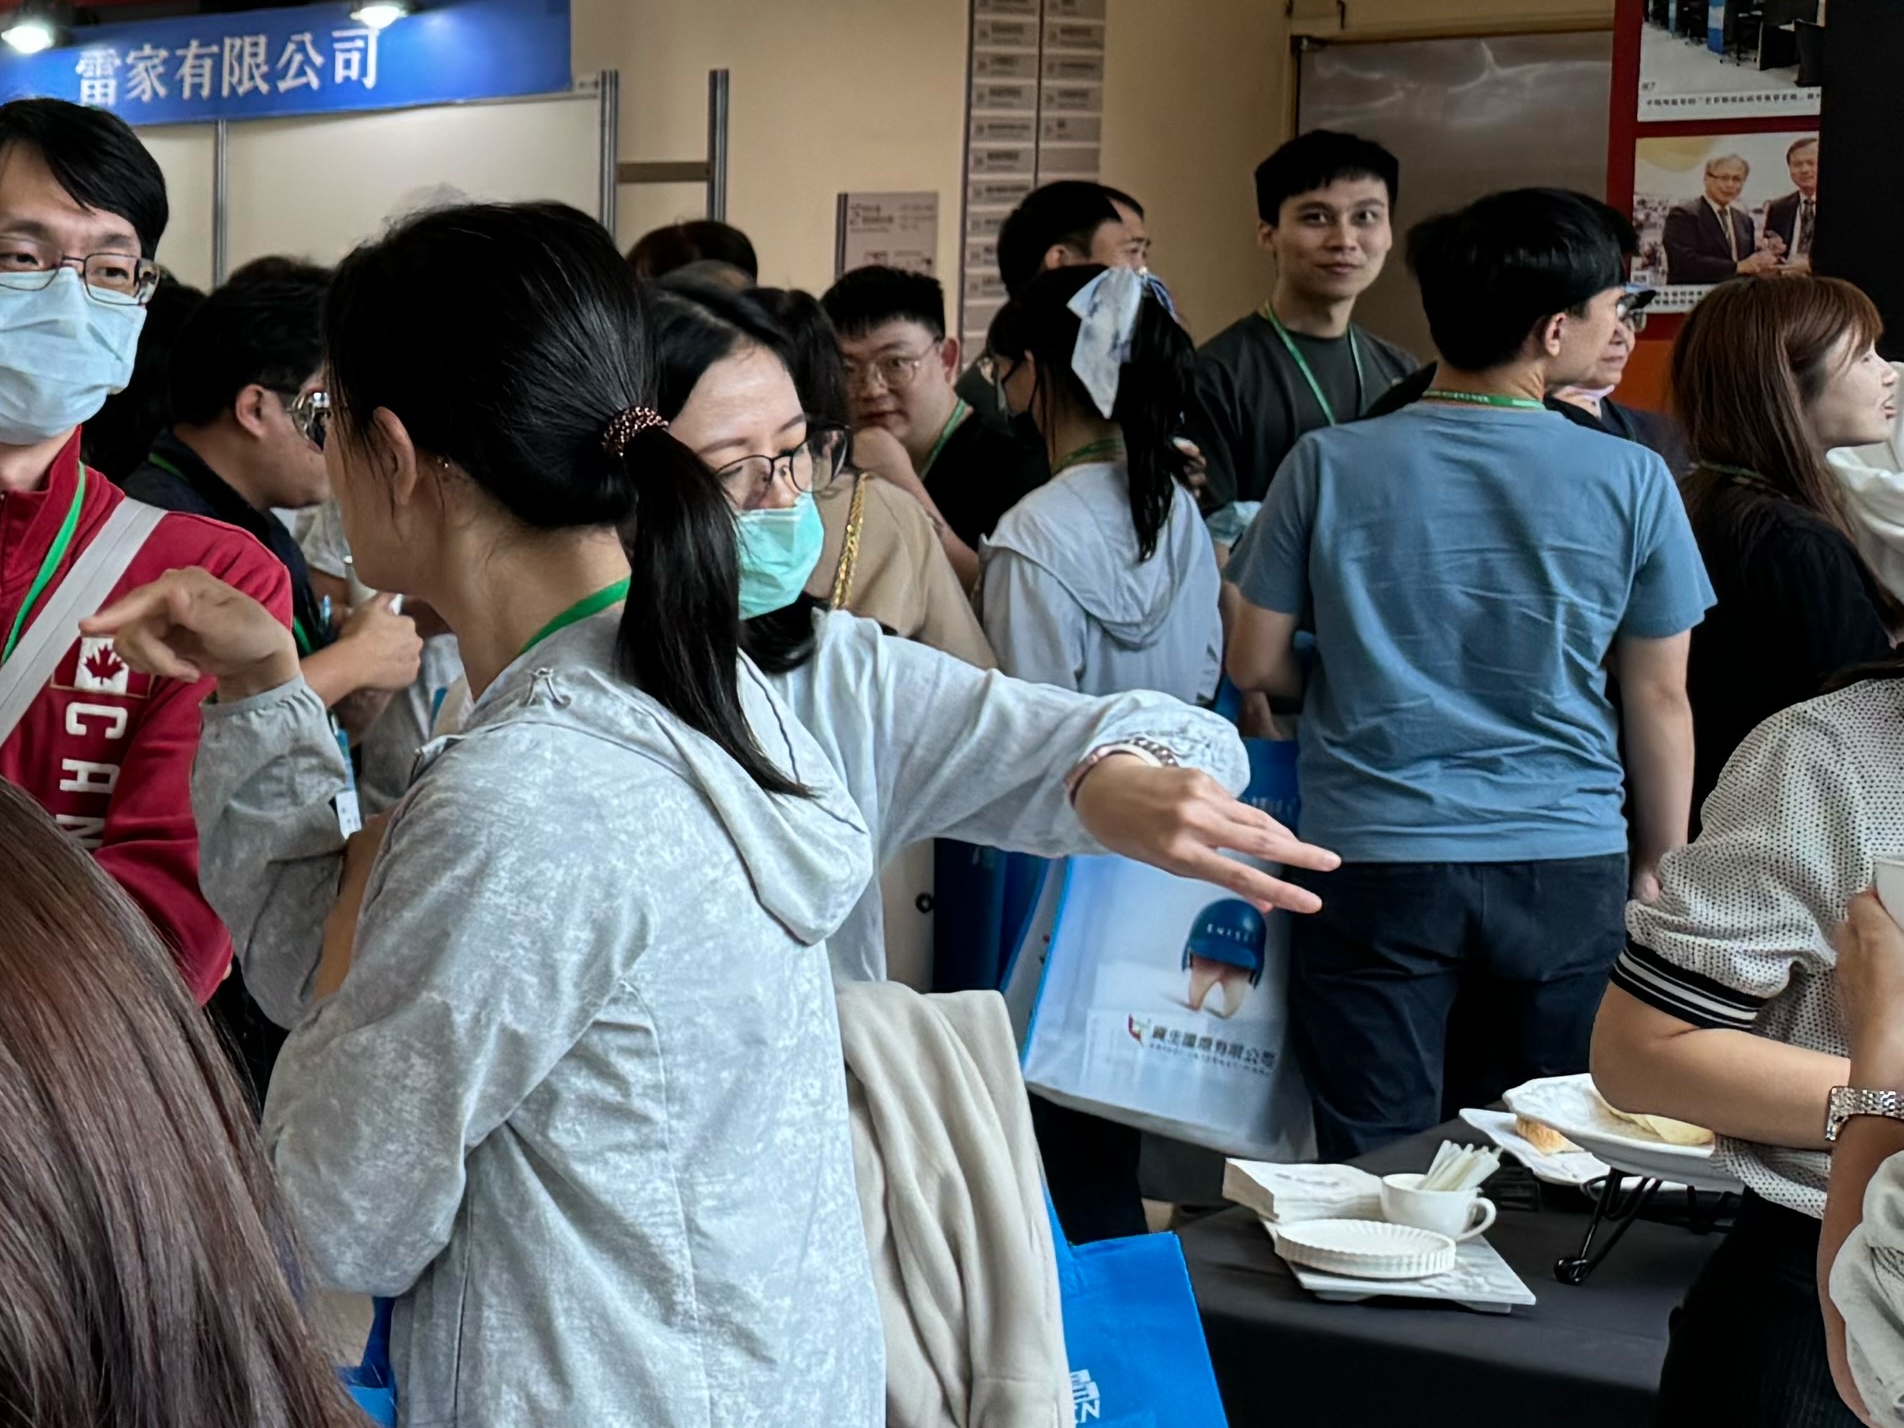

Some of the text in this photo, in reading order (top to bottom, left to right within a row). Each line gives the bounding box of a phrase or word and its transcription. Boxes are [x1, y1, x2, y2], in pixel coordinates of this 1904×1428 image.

[74, 26, 380, 108] 雷家有限公司
